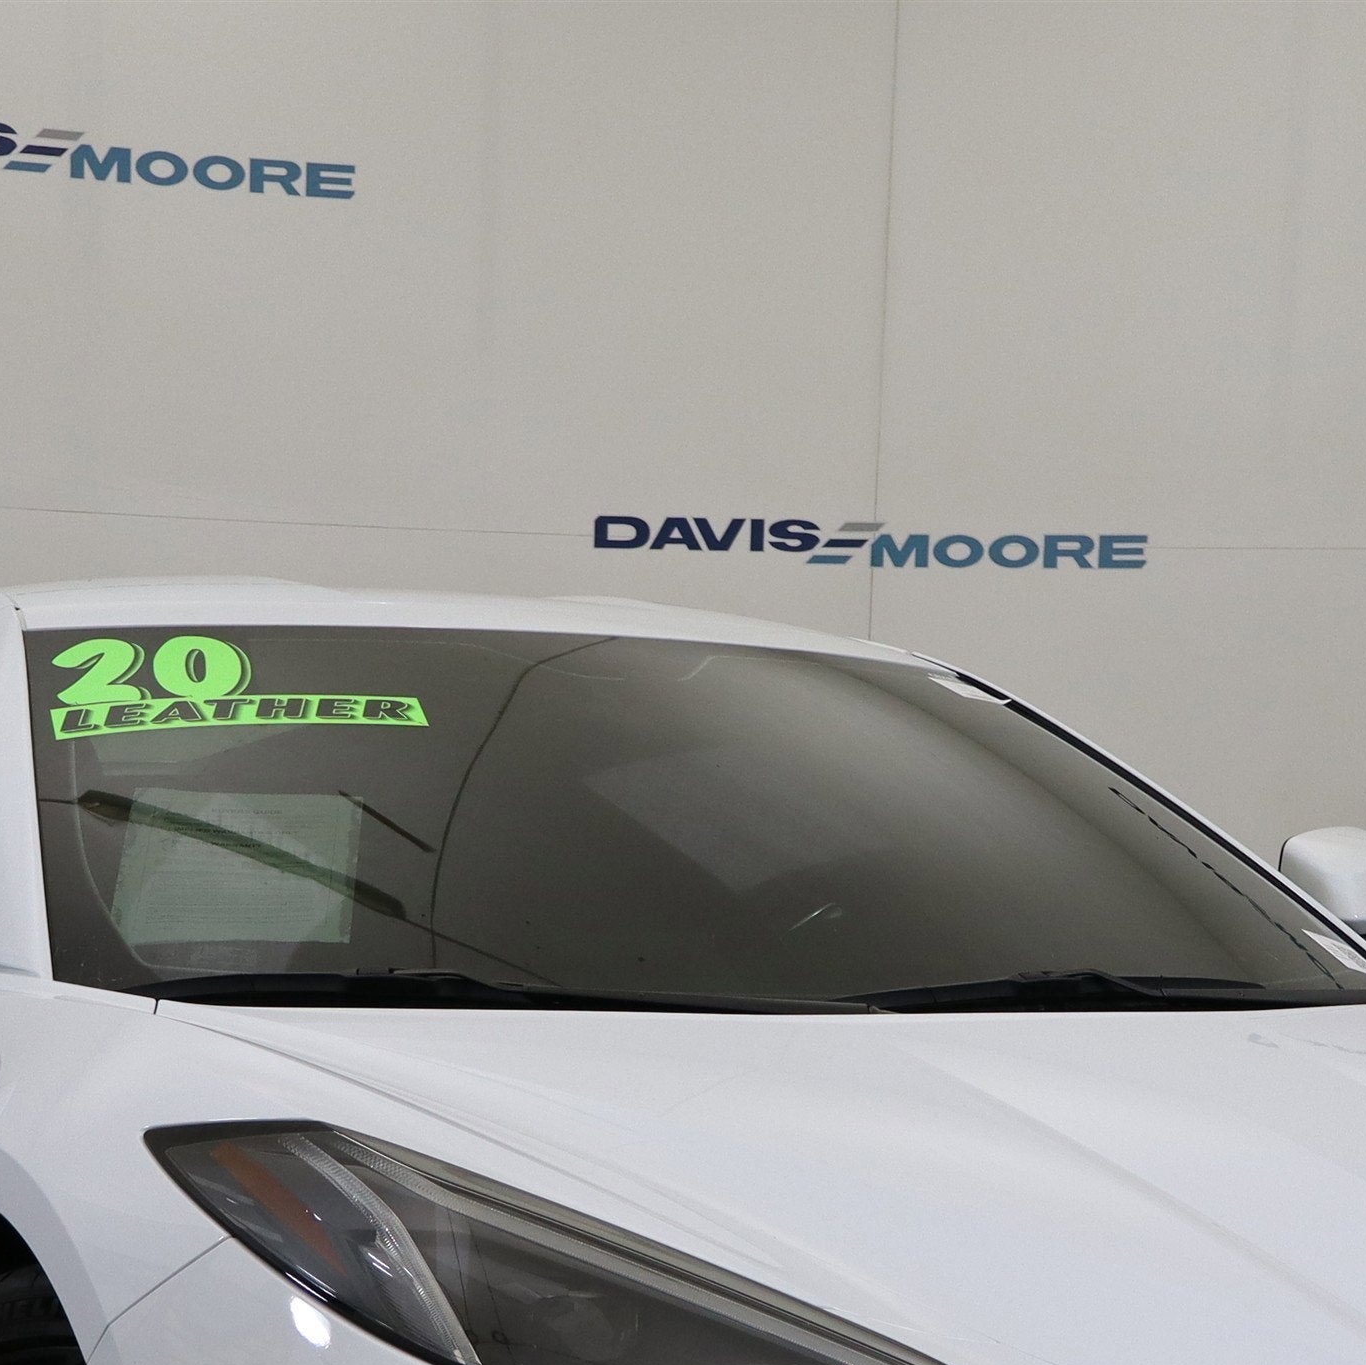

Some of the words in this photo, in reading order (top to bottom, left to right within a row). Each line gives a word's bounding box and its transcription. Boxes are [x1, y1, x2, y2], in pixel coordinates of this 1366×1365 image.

[70, 143, 355, 200] MOORE
[593, 515, 821, 552] DAVIS
[870, 534, 1148, 569] MOORE
[51, 635, 252, 706] 20
[60, 698, 419, 733] LEATHER
